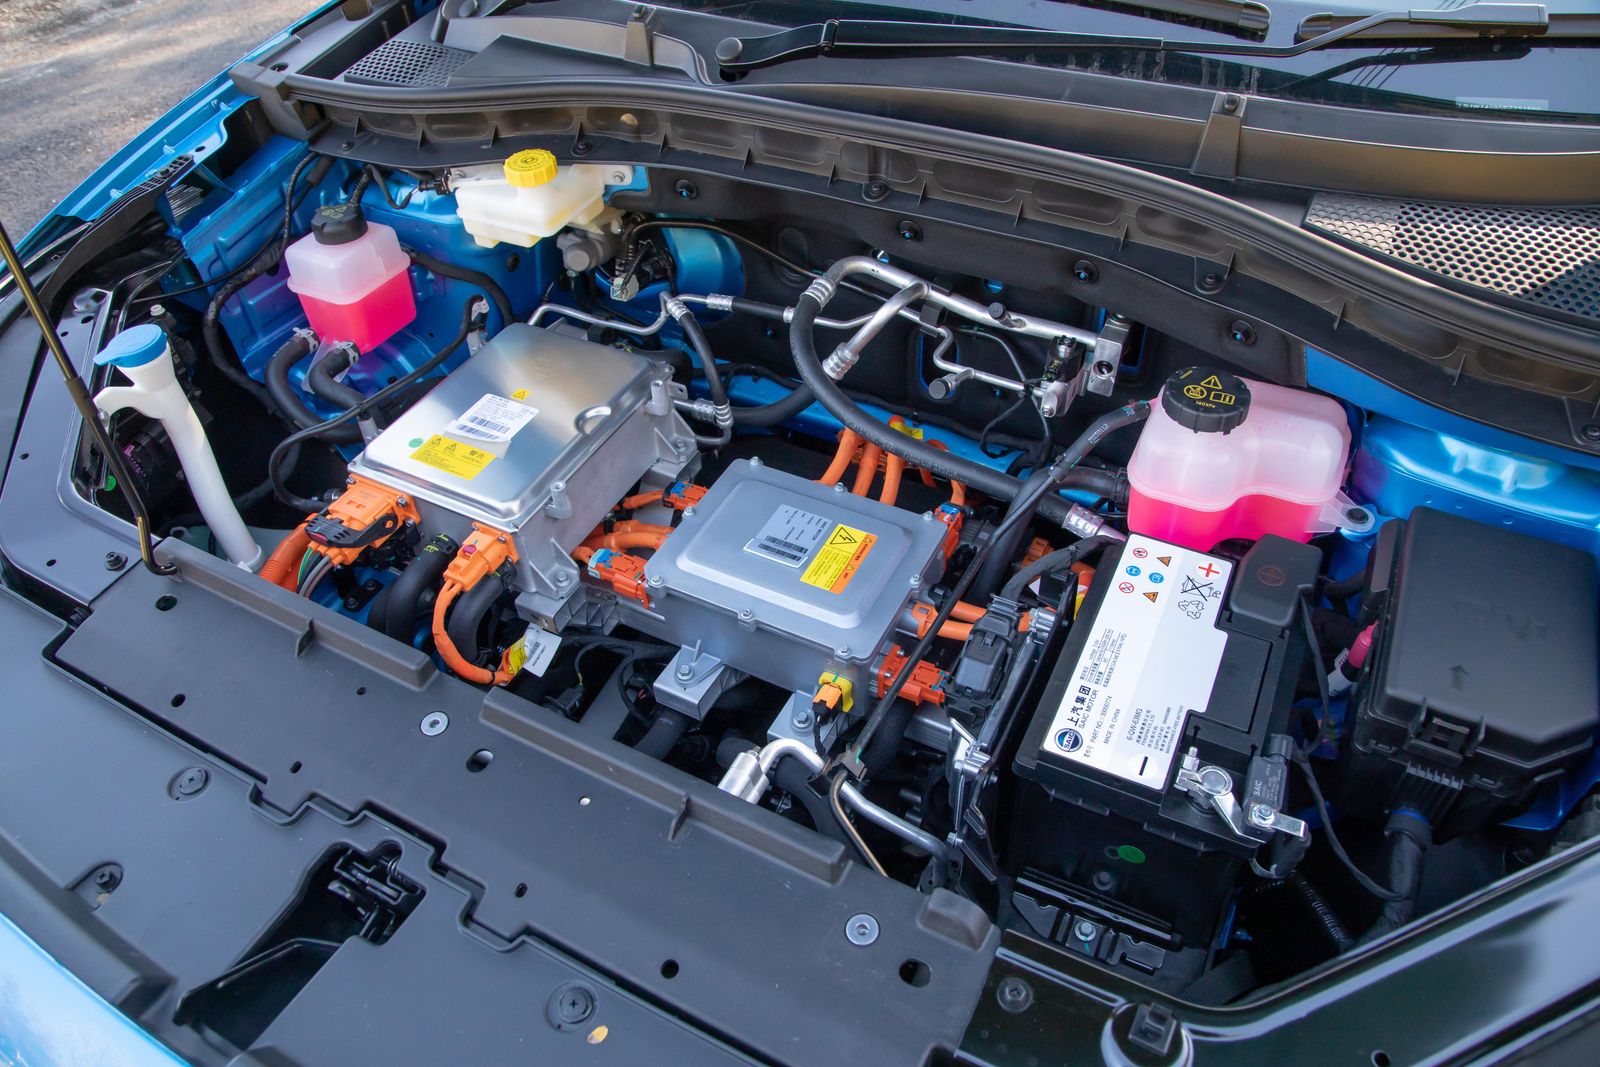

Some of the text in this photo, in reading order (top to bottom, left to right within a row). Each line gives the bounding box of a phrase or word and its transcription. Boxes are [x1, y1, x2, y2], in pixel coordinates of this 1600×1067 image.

[1067, 685, 1091, 726] 上汽集团
[1078, 689, 1099, 729] SAIC MOTOR
[1090, 729, 1099, 743] PART
[1103, 730, 1112, 744] MADE
[1111, 708, 1120, 723] CHINA
[1064, 731, 1075, 750] SAIC
[1252, 779, 1263, 797] SAIC
